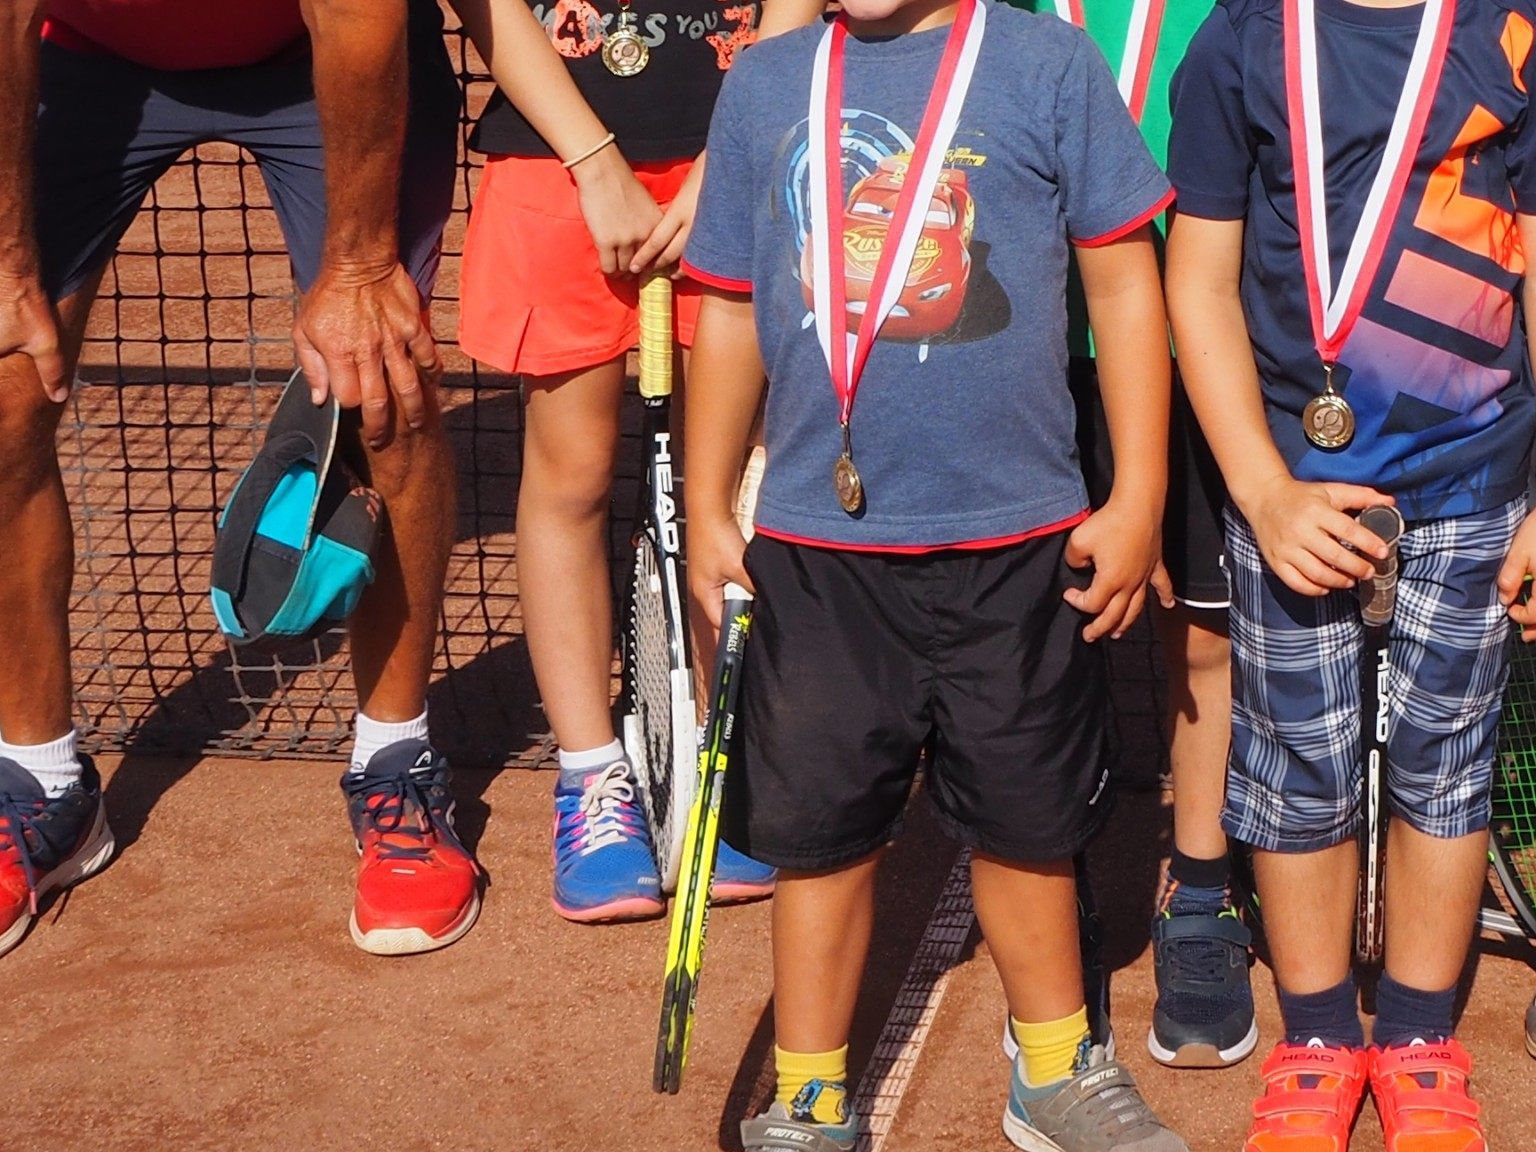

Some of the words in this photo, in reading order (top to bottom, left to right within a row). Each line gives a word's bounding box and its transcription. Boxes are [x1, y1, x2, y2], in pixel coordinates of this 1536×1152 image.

[676, 11, 719, 40] YOU
[655, 432, 680, 553] HEAD
[1376, 648, 1390, 743] HEAD
[1281, 1053, 1335, 1063] HEAD
[1400, 1051, 1452, 1063] HEAD
[763, 1127, 816, 1143] PROTECT
